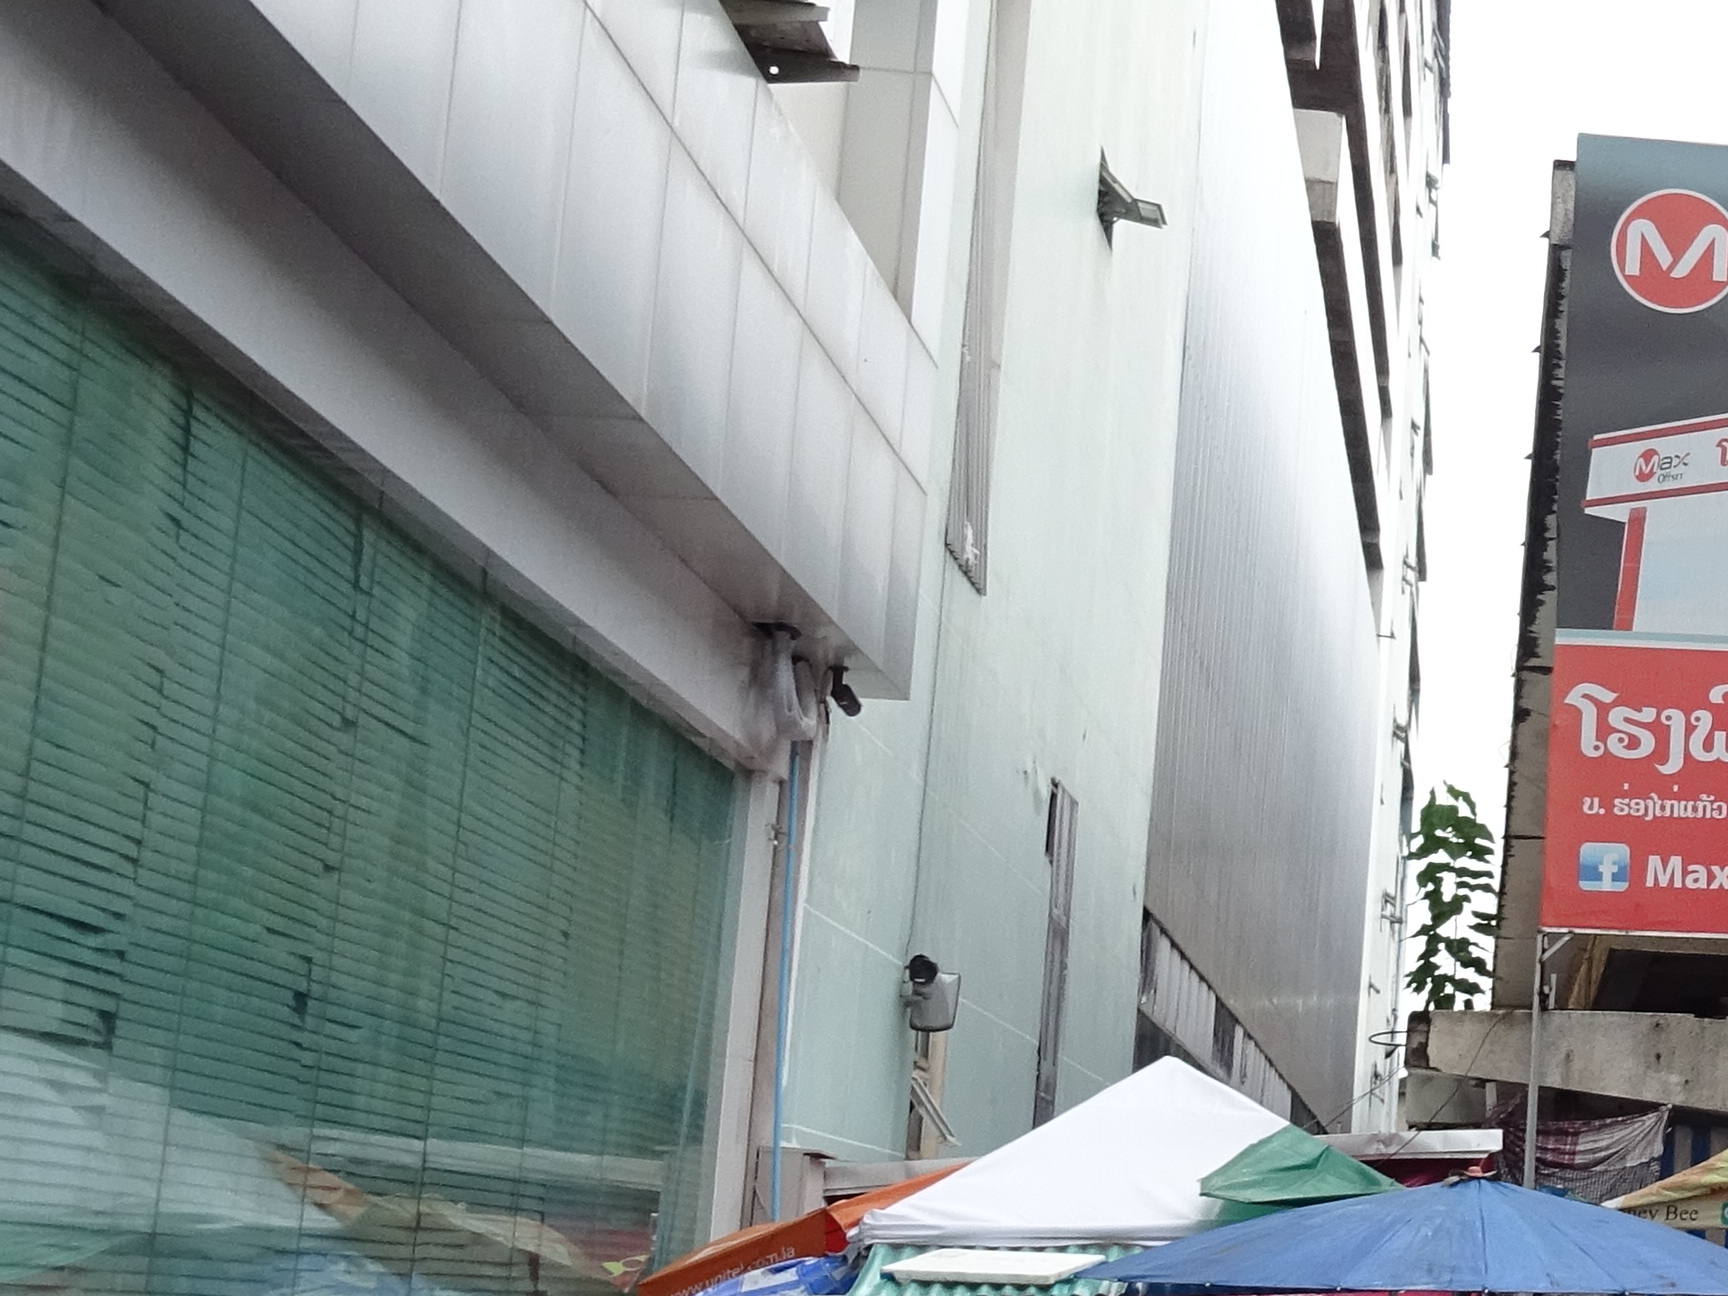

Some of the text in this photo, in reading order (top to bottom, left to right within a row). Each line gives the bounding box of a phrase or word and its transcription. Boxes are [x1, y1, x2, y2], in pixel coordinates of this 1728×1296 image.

[1634, 451, 1691, 477] Max
[1582, 796, 1606, 815] ບ.
[1665, 1204, 1699, 1222] Bee
